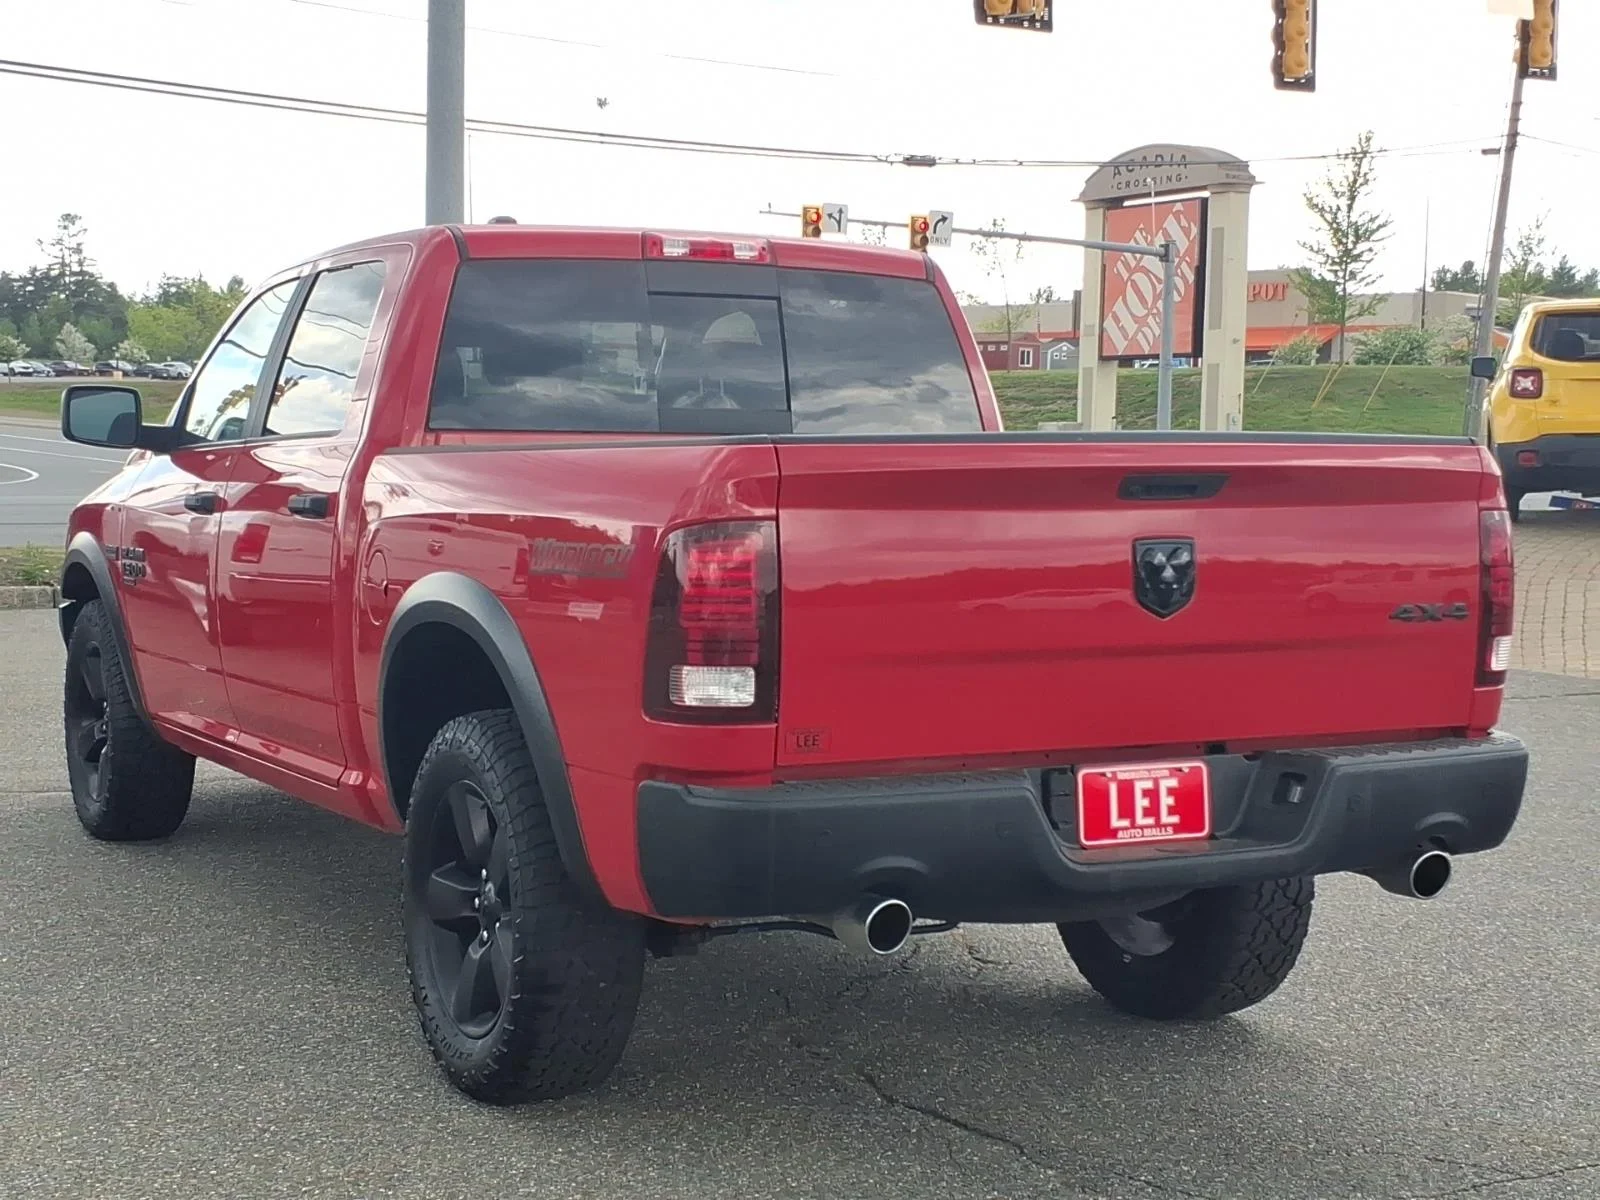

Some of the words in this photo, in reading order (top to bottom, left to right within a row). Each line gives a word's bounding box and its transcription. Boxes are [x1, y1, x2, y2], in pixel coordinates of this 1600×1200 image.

[1113, 153, 1187, 178] ACADIA
[930, 235, 949, 244] ONLY
[1113, 223, 1151, 282] THE
[796, 734, 820, 748] LEE
[1109, 778, 1180, 828] LEE
[1118, 828, 1142, 838] AUTO
[1143, 826, 1173, 837] MALLS
